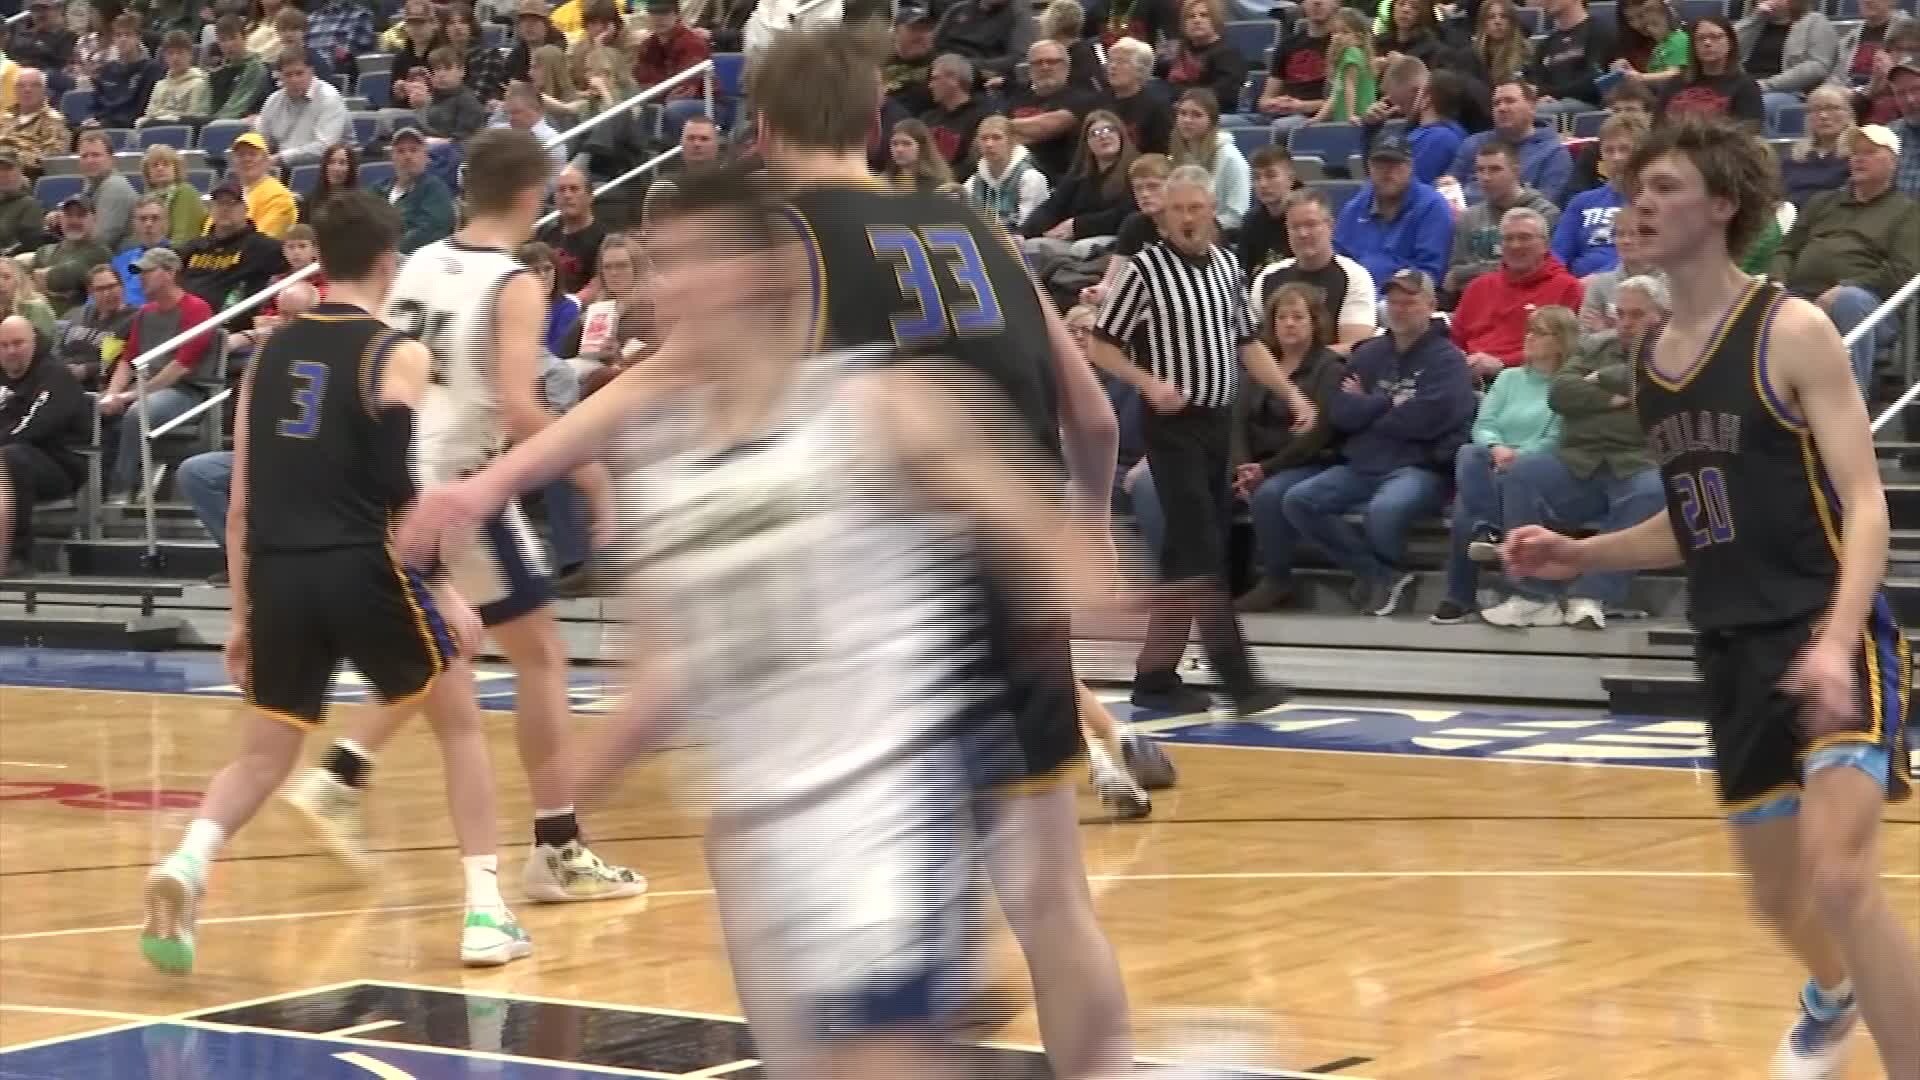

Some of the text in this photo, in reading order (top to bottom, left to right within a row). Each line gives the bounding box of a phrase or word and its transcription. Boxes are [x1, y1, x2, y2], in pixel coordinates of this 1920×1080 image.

[865, 224, 1005, 348] 33
[275, 359, 331, 439] 3
[1670, 467, 1736, 550] 20
